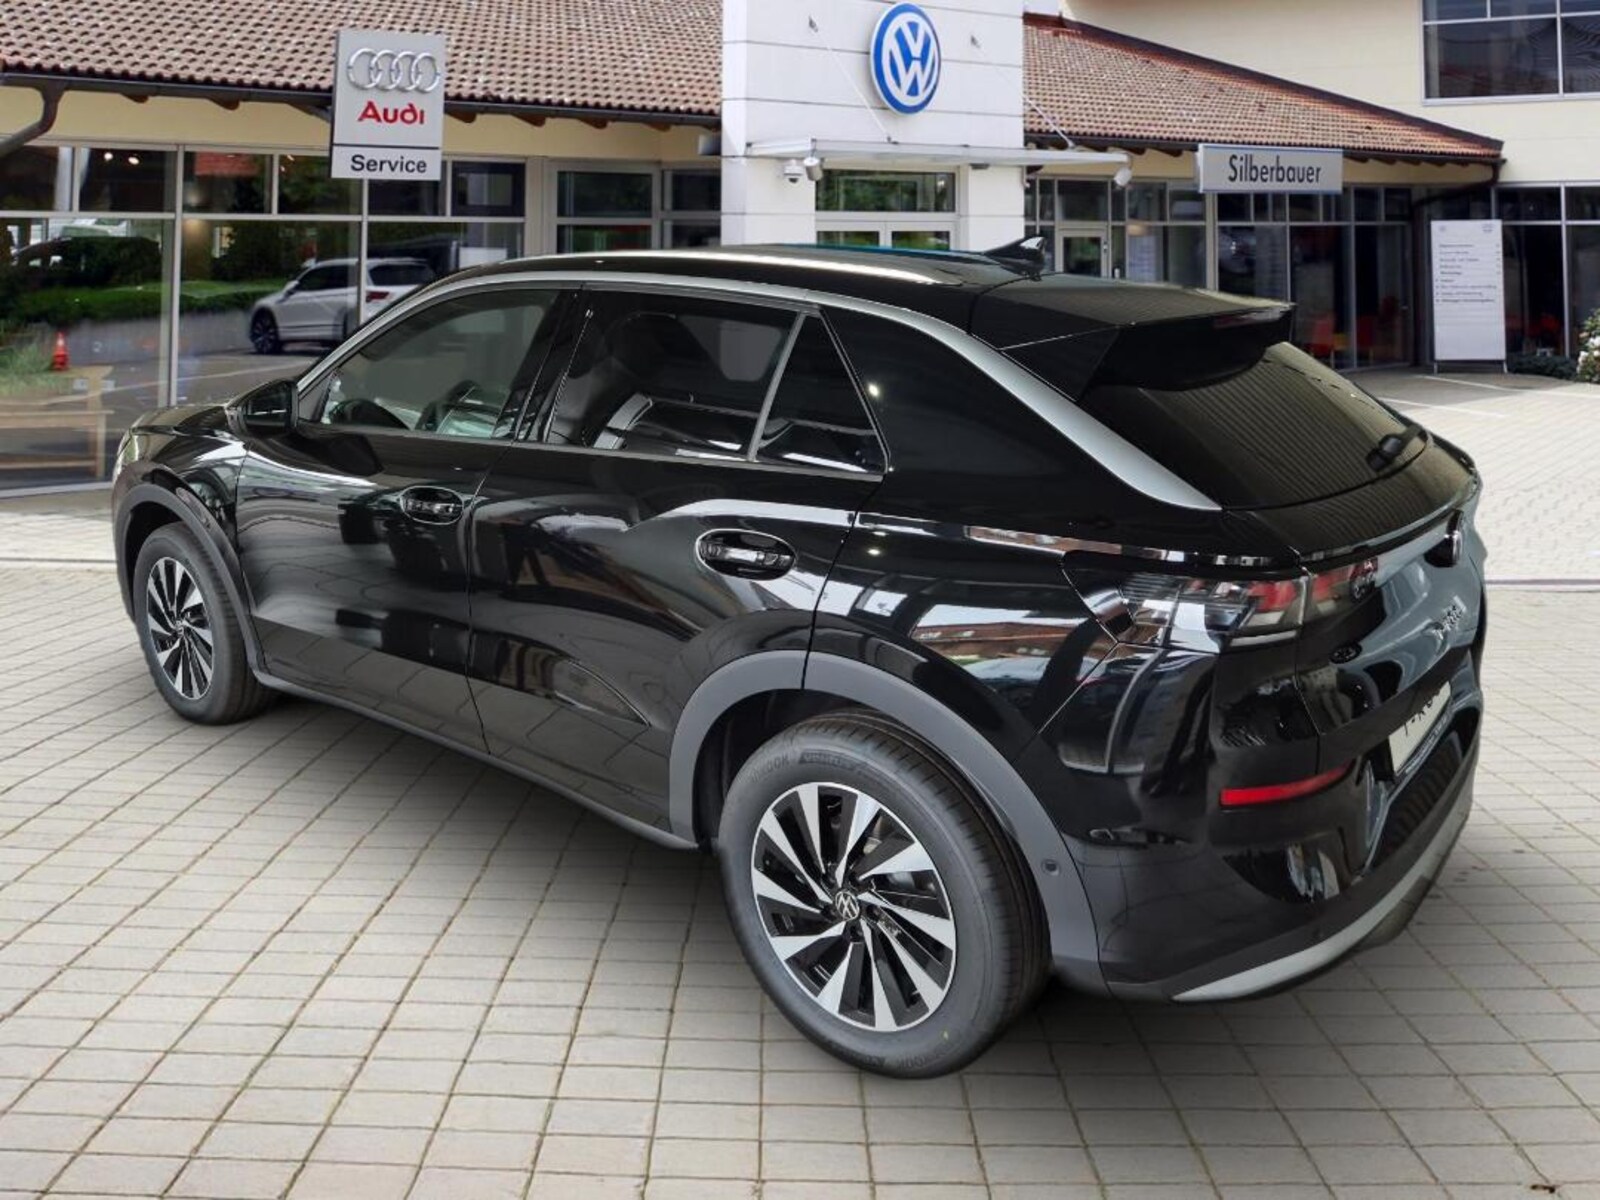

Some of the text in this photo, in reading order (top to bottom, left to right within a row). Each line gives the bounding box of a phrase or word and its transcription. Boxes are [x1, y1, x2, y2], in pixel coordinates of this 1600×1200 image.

[357, 100, 425, 125] Audi
[350, 153, 428, 174] Service
[1227, 153, 1322, 184] Silberbauer
